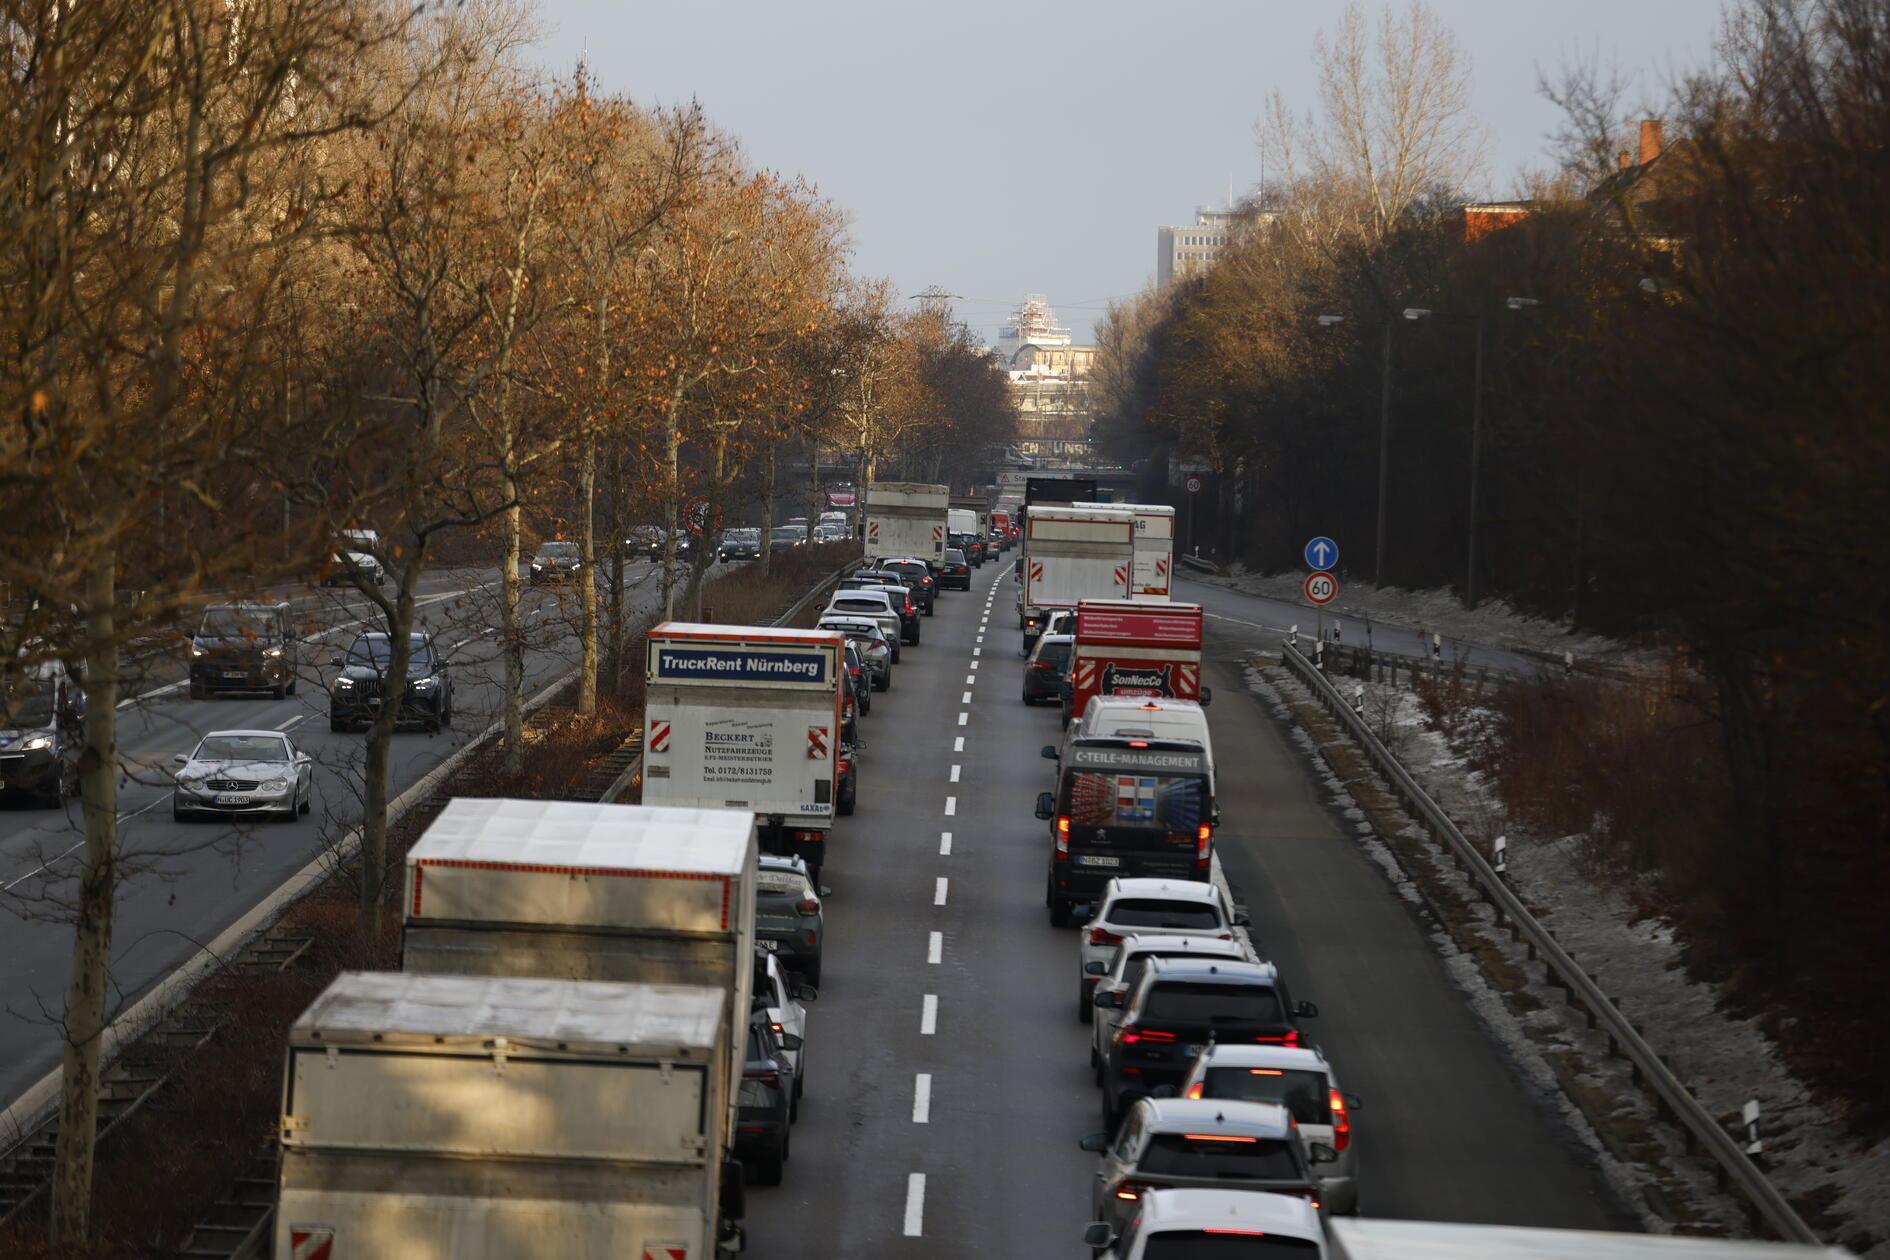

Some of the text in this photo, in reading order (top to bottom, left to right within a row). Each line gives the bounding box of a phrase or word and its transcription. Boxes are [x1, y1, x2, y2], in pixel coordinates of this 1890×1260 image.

[1189, 480, 1199, 489] 60
[1312, 581, 1330, 595] 60
[747, 658, 818, 677] Nürnberg
[1112, 674, 1162, 686] SonNecCo
[1076, 752, 1200, 768] C-TEILE-MANAGEMENT
